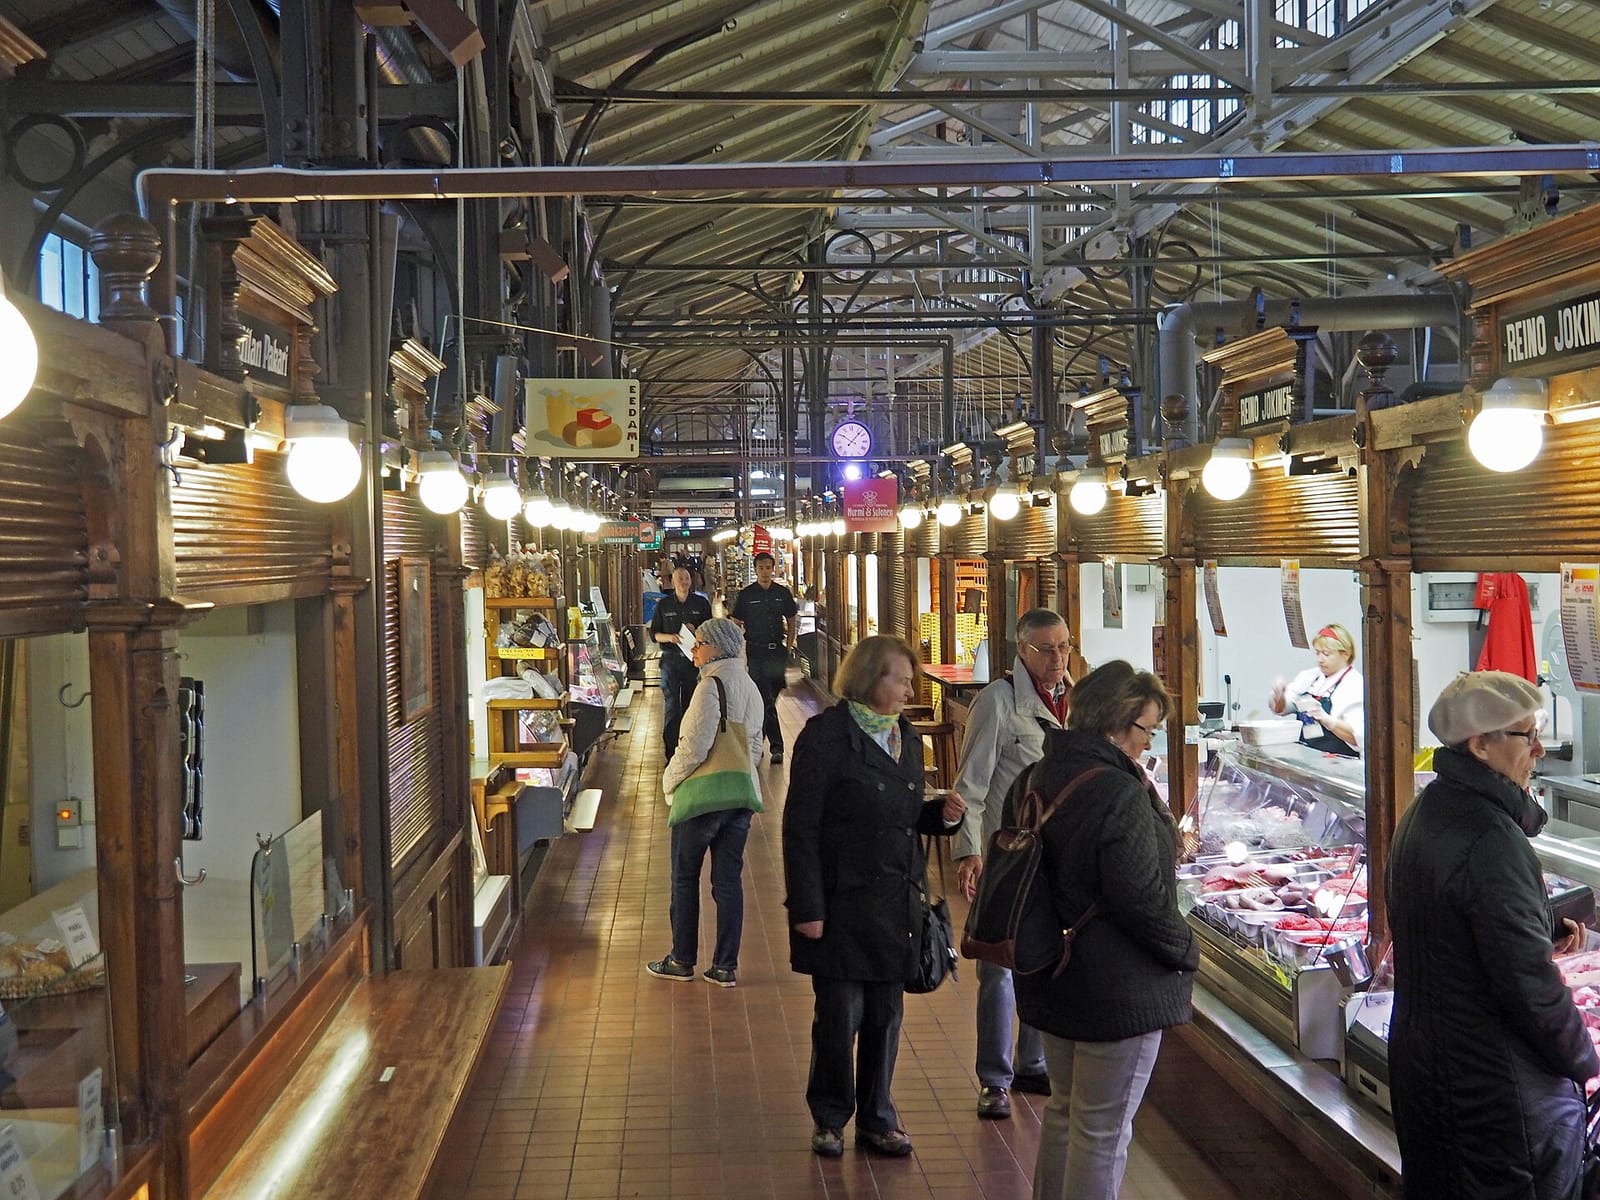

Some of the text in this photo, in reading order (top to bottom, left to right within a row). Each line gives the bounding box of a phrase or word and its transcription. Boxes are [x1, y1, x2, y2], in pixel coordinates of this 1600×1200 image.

[262, 334, 289, 377] Pakari
[1506, 315, 1547, 363] REINO
[627, 385, 638, 452] EEDAMI
[1240, 395, 1259, 426] REINO
